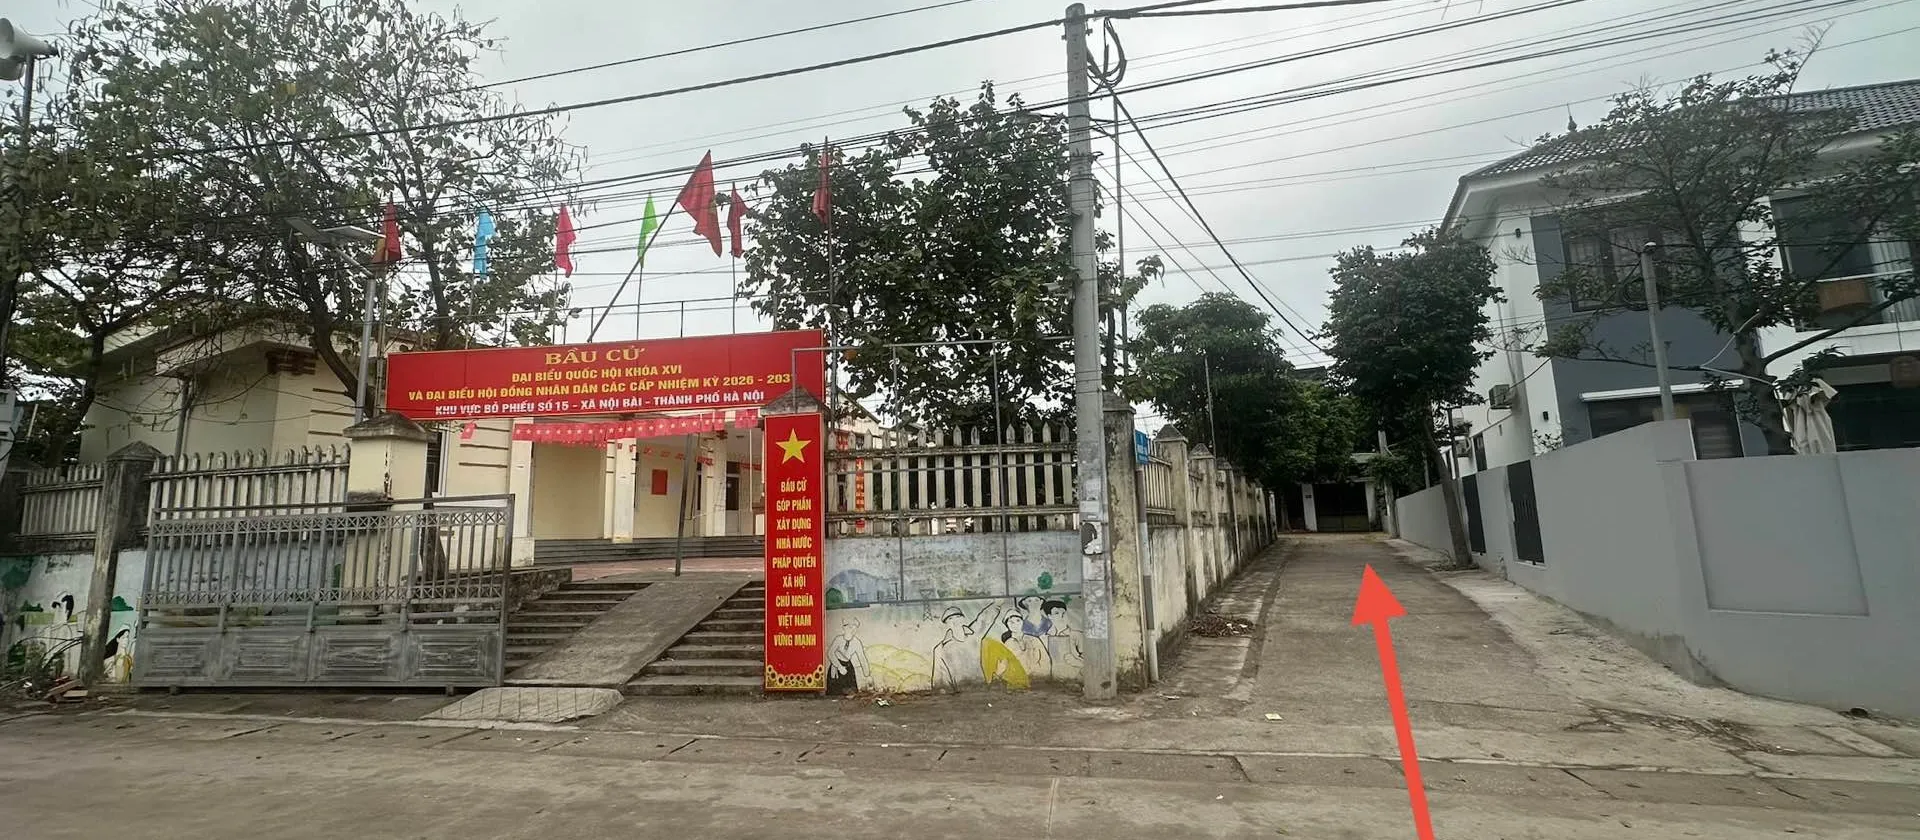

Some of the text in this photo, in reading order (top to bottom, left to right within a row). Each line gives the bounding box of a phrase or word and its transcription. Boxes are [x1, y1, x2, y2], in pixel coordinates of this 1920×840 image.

[545, 345, 645, 365] BẦU CỬ
[512, 364, 682, 384] ĐẠI BIỂU QUỐC HỘI KHÓA XVI
[408, 390, 423, 400] VÀ
[426, 390, 445, 402] ĐẠI
[448, 386, 475, 399] BIỂU
[478, 386, 497, 400] HỘI
[500, 385, 532, 398] ĐỒNG
[536, 384, 569, 396] NHÂN
[573, 382, 598, 394] DÂN
[601, 382, 626, 393] CÁC
[630, 378, 655, 391] CẤP
[658, 377, 699, 391] NHIỆM
[703, 375, 720, 387] KỲ
[723, 375, 754, 386] 2026
[435, 405, 457, 416] KHU
[460, 403, 481, 416] VỰC
[484, 401, 499, 413] BỎ
[502, 399, 535, 413] PHIẾU
[538, 399, 553, 412] SỐ
[556, 401, 569, 411] 15
[581, 400, 596, 410] XÃ
[599, 398, 619, 411] NỘI
[622, 396, 642, 407] BÀI
[653, 394, 693, 406] THÀNH
[696, 390, 720, 404] PHỐ
[723, 391, 740, 403] HÀ
[743, 390, 764, 403] NỘI
[776, 534, 813, 549] NHÀ NƯỚC
[772, 554, 792, 569] PHÁP
[782, 574, 806, 589] XÃ HỘI
[775, 591, 814, 607] CHỦ NGHĨA
[777, 613, 812, 628] VIỆT NAM
[794, 635, 817, 648] MẠNH
